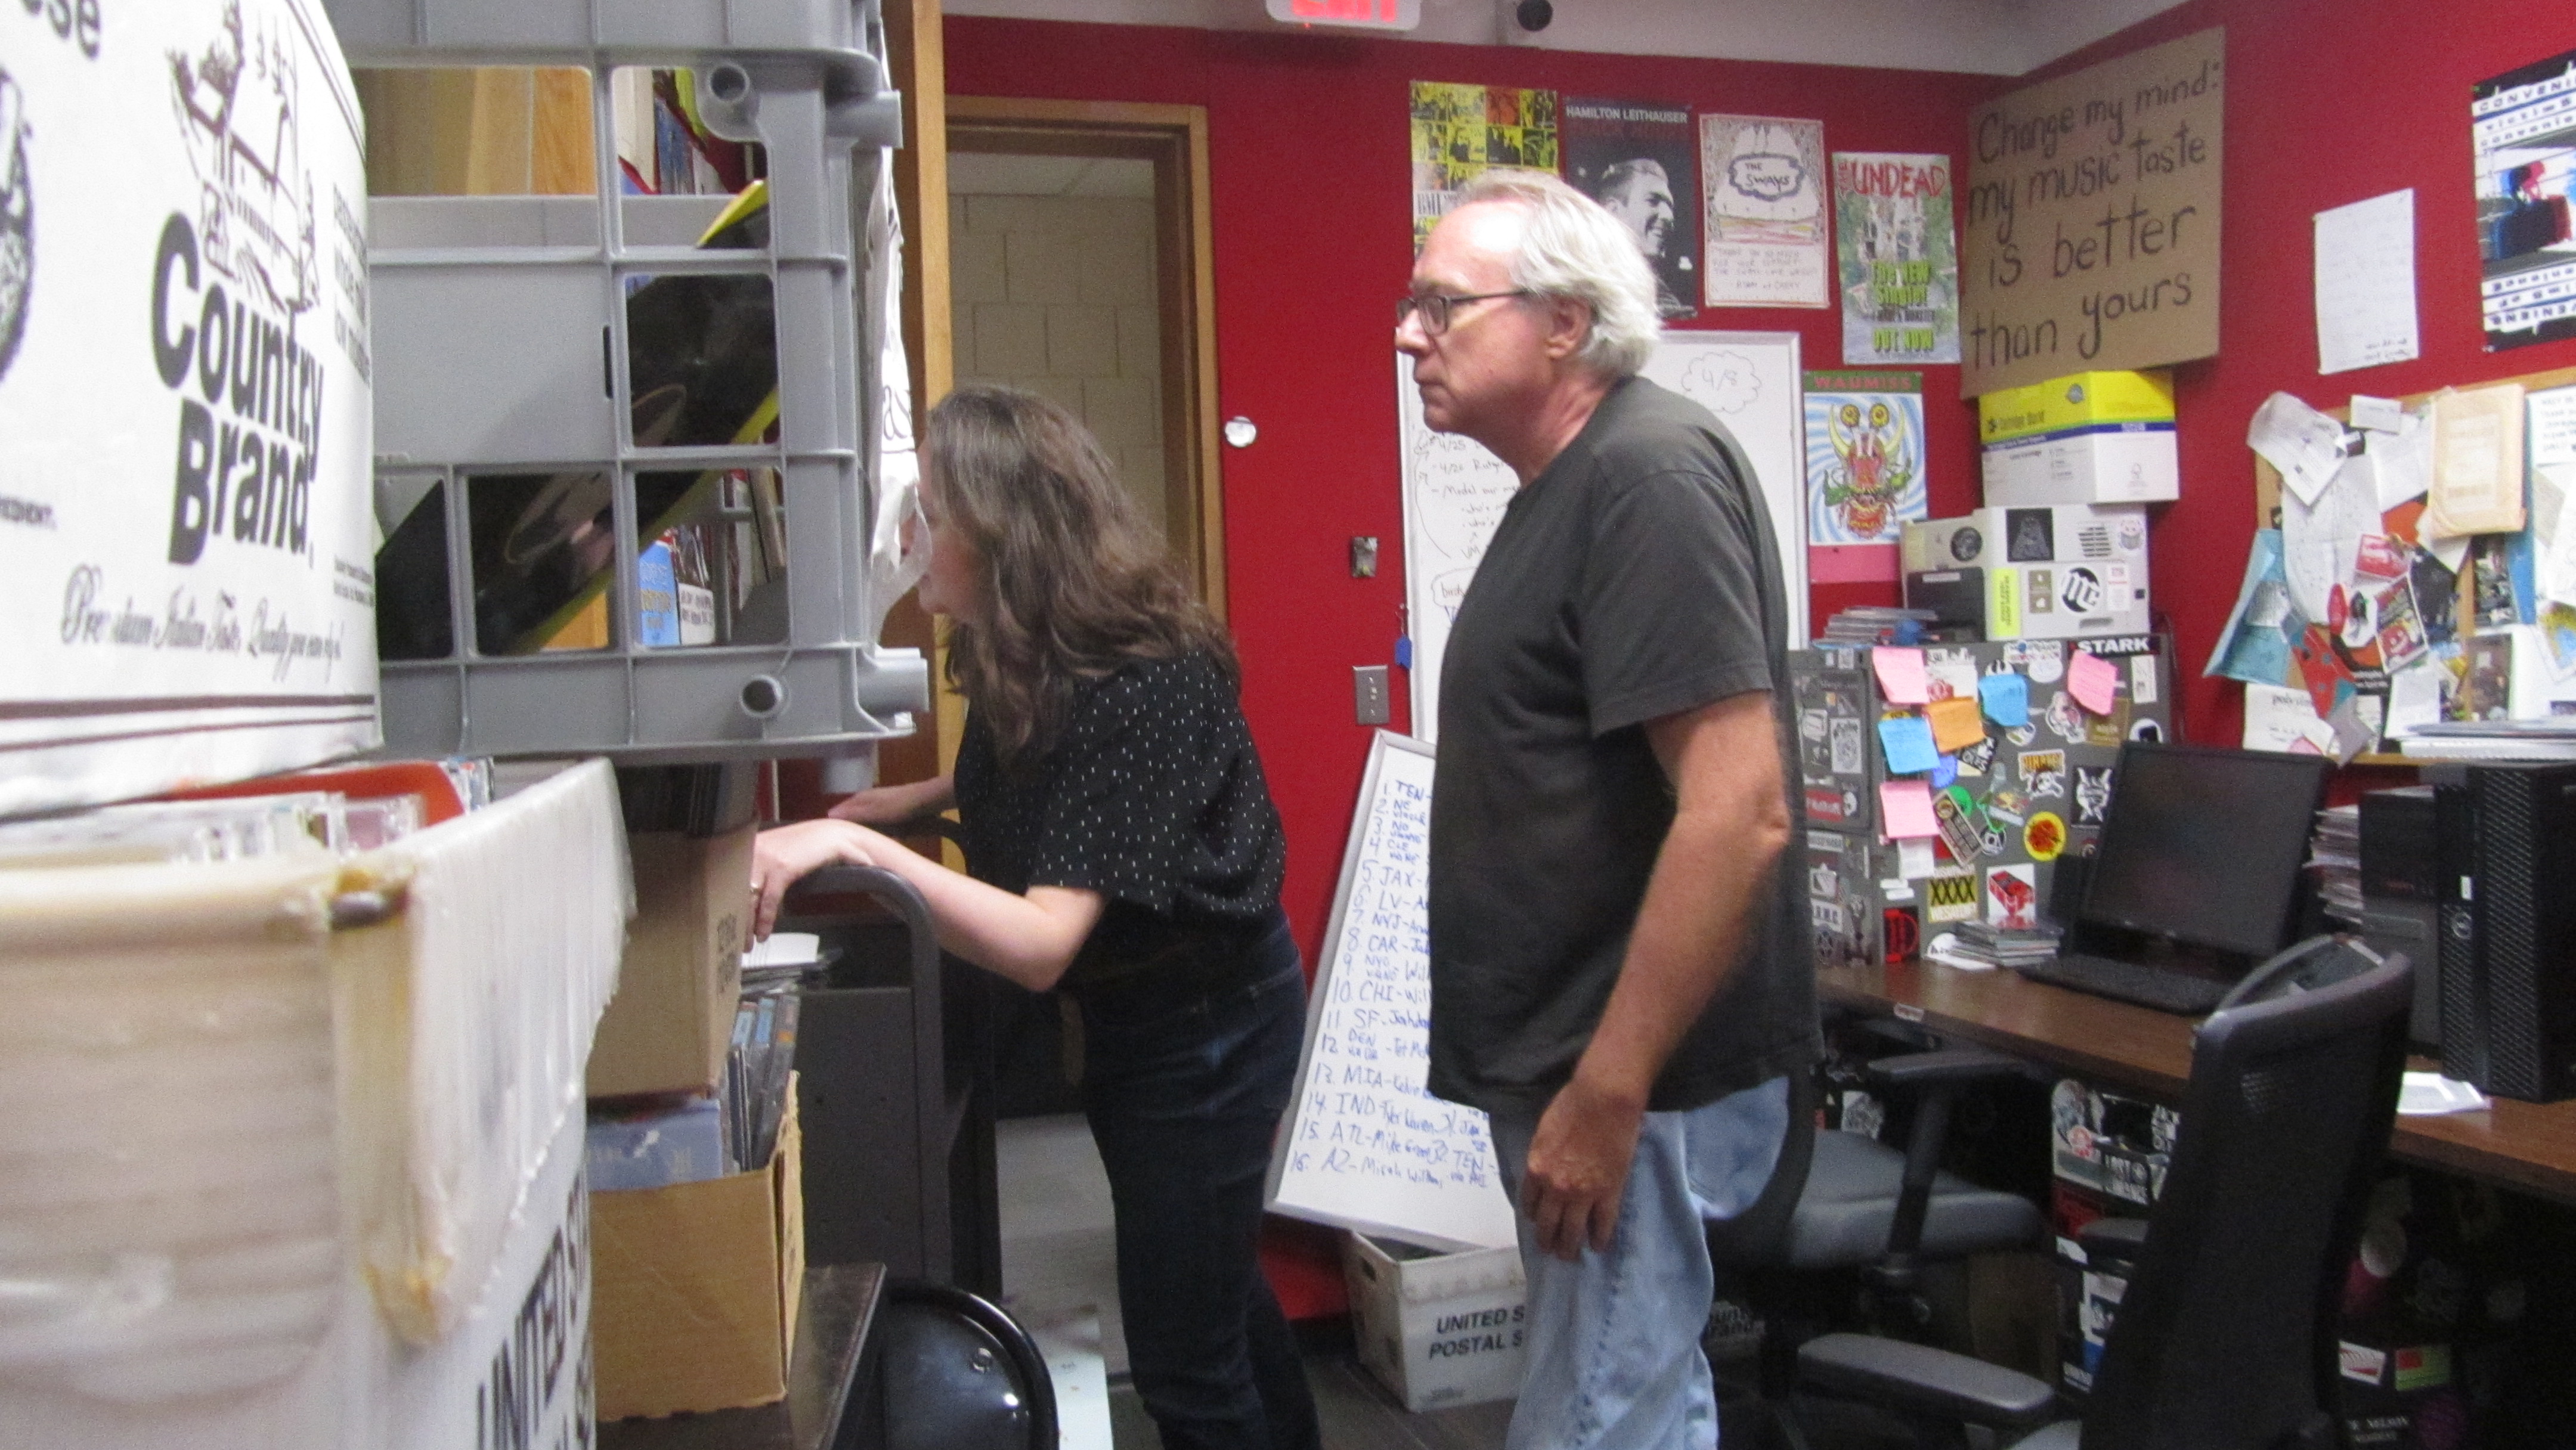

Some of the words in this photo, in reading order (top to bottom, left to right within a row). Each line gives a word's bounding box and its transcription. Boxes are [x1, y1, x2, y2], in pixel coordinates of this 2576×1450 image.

[1566, 106, 1621, 119] HAMILTON
[1623, 109, 1688, 123] LEITHAUSER
[1978, 106, 2075, 166] Change
[2085, 97, 2124, 145] my
[2135, 60, 2220, 114] mind:
[1744, 162, 1761, 171] THE
[1850, 161, 1946, 198] UNDEAD
[1968, 178, 2015, 245] my
[2129, 120, 2206, 181] taste
[1989, 243, 2023, 289] is
[2054, 192, 2197, 279] better
[1971, 312, 2057, 371] than
[2079, 273, 2193, 360] yours
[150, 211, 324, 482] Country
[2077, 638, 2150, 656] STARK
[1930, 874, 1976, 907] XXXX
[1436, 1308, 1507, 1334] UNITED
[1429, 1333, 1506, 1359] POSTAL
